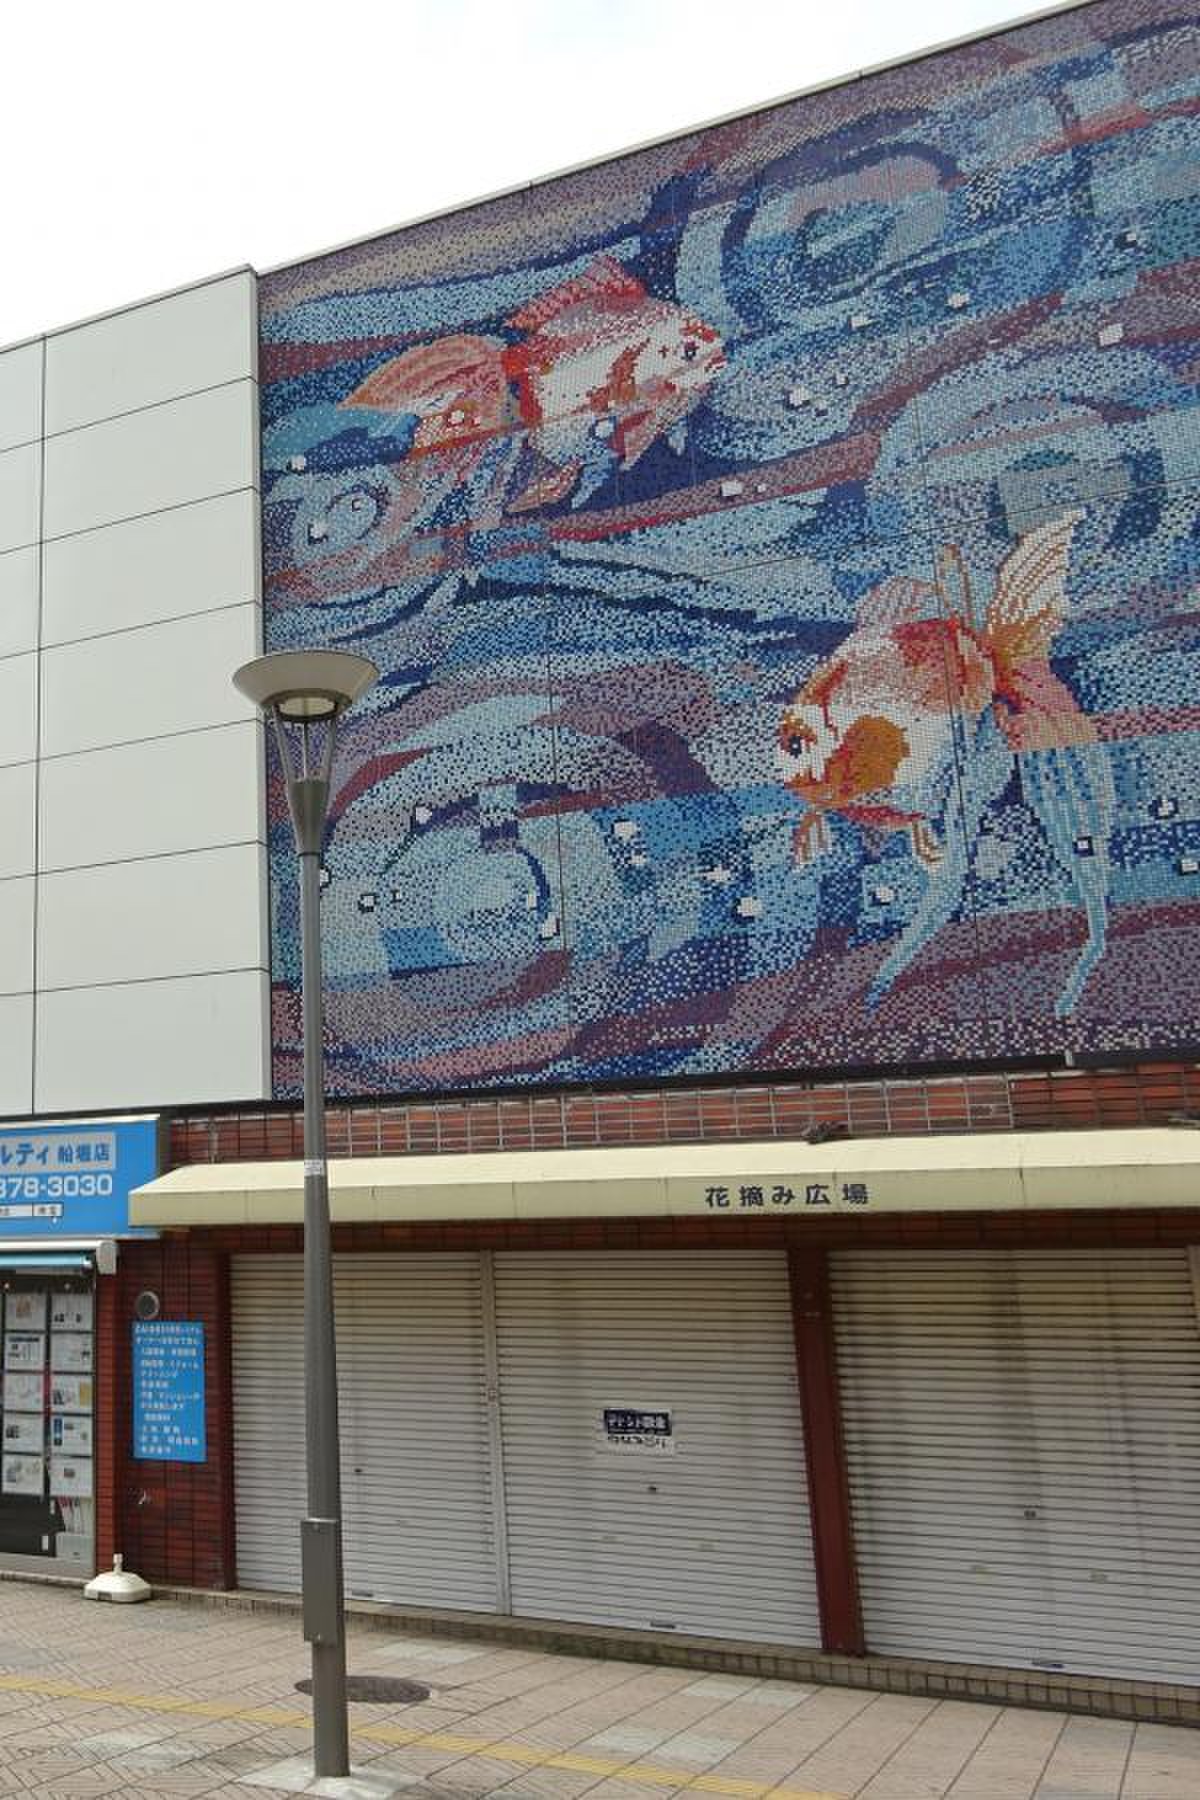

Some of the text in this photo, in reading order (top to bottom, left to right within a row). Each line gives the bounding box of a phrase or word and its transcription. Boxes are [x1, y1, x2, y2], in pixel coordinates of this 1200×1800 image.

[57, 1142, 111, 1164] 船堀店
[705, 1183, 870, 1208] 花摘み広場
